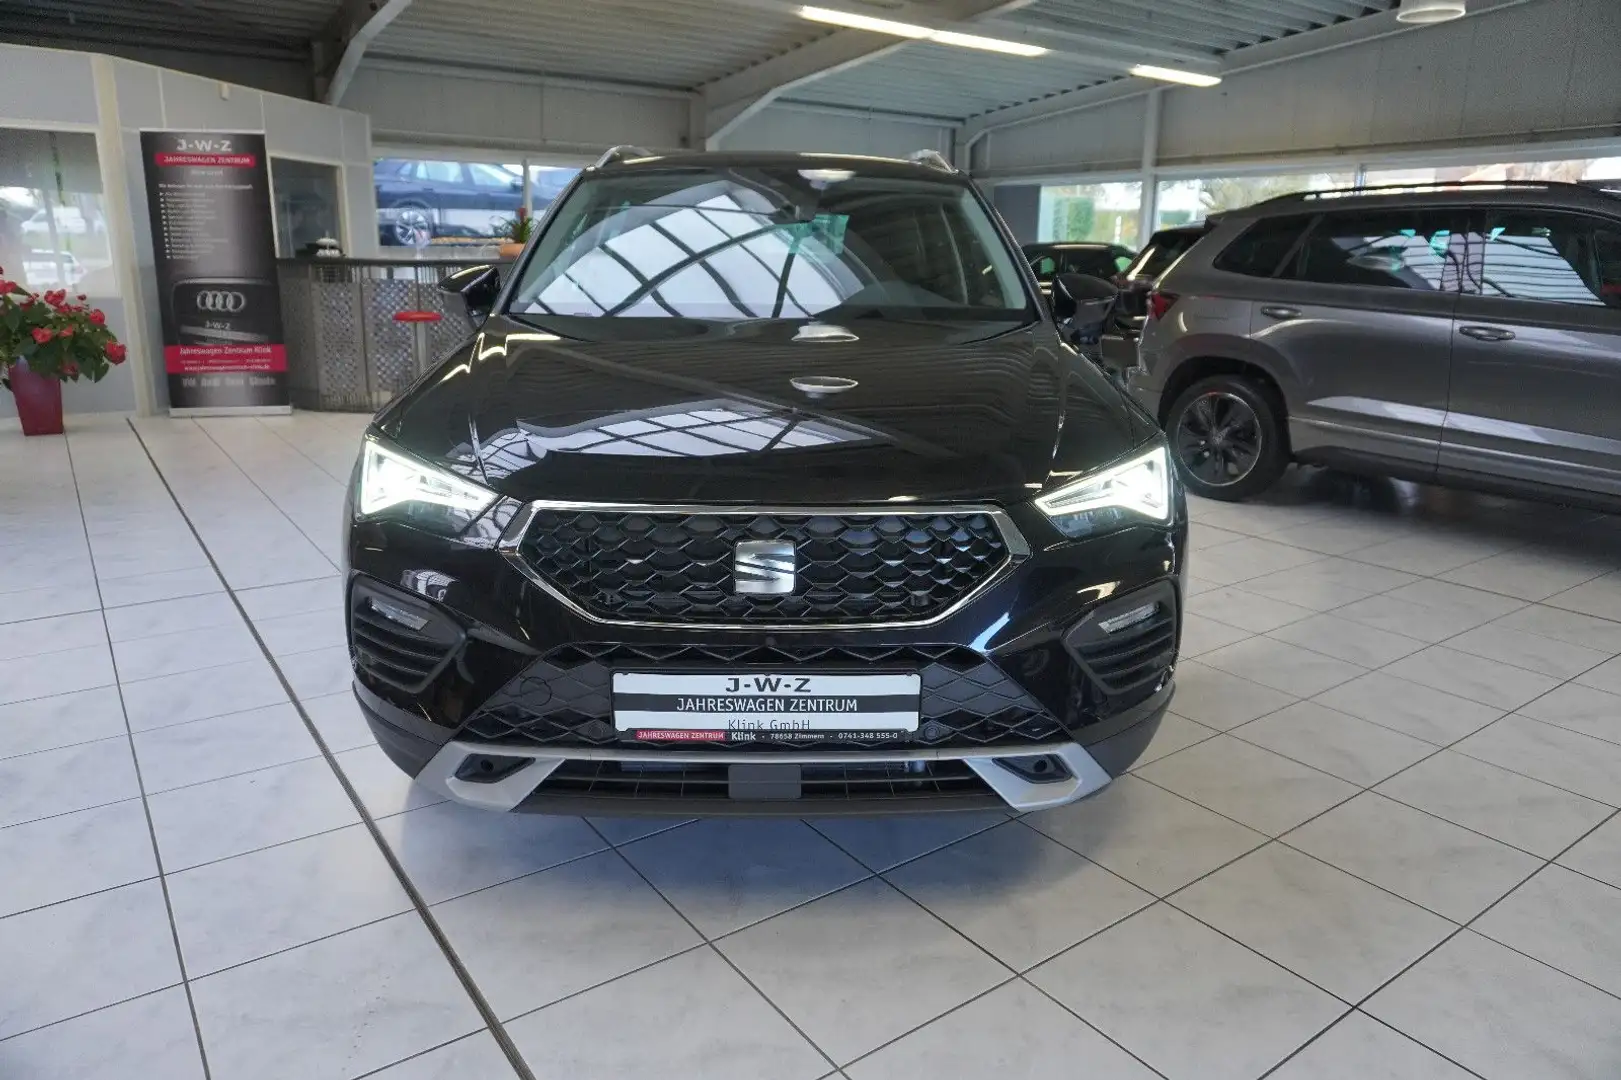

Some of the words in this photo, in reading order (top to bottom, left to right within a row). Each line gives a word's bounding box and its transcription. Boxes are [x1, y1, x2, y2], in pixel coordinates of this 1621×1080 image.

[176, 138, 232, 152] J-W-Z
[223, 346, 253, 354] Zentrum
[725, 677, 812, 693] J-W-Z
[676, 697, 785, 713] JAHRESWAGEN
[789, 698, 858, 712] ZENTRUM
[728, 719, 764, 730] Klink
[769, 719, 810, 730] GmbH
[638, 731, 689, 740] JAHRESWAGEN
[691, 732, 724, 740] ZENTRUM
[731, 731, 756, 741] Klink
